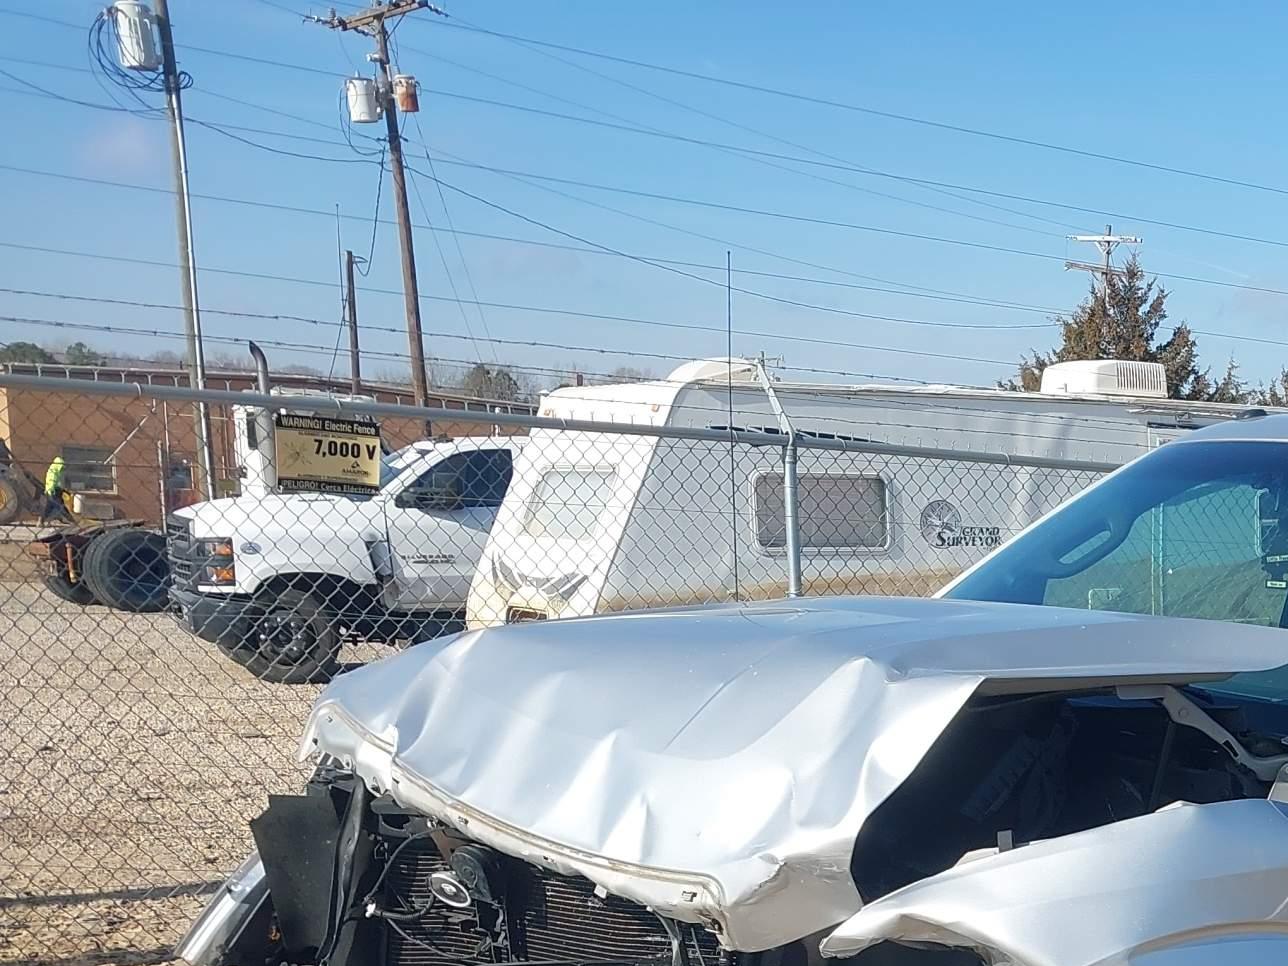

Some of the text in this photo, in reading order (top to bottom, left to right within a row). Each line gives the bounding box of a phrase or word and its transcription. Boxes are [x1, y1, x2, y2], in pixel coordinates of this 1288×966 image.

[281, 415, 376, 435] WARNING! Electric Fence
[314, 439, 377, 460] 7,000 V
[962, 526, 1001, 536] GRAND
